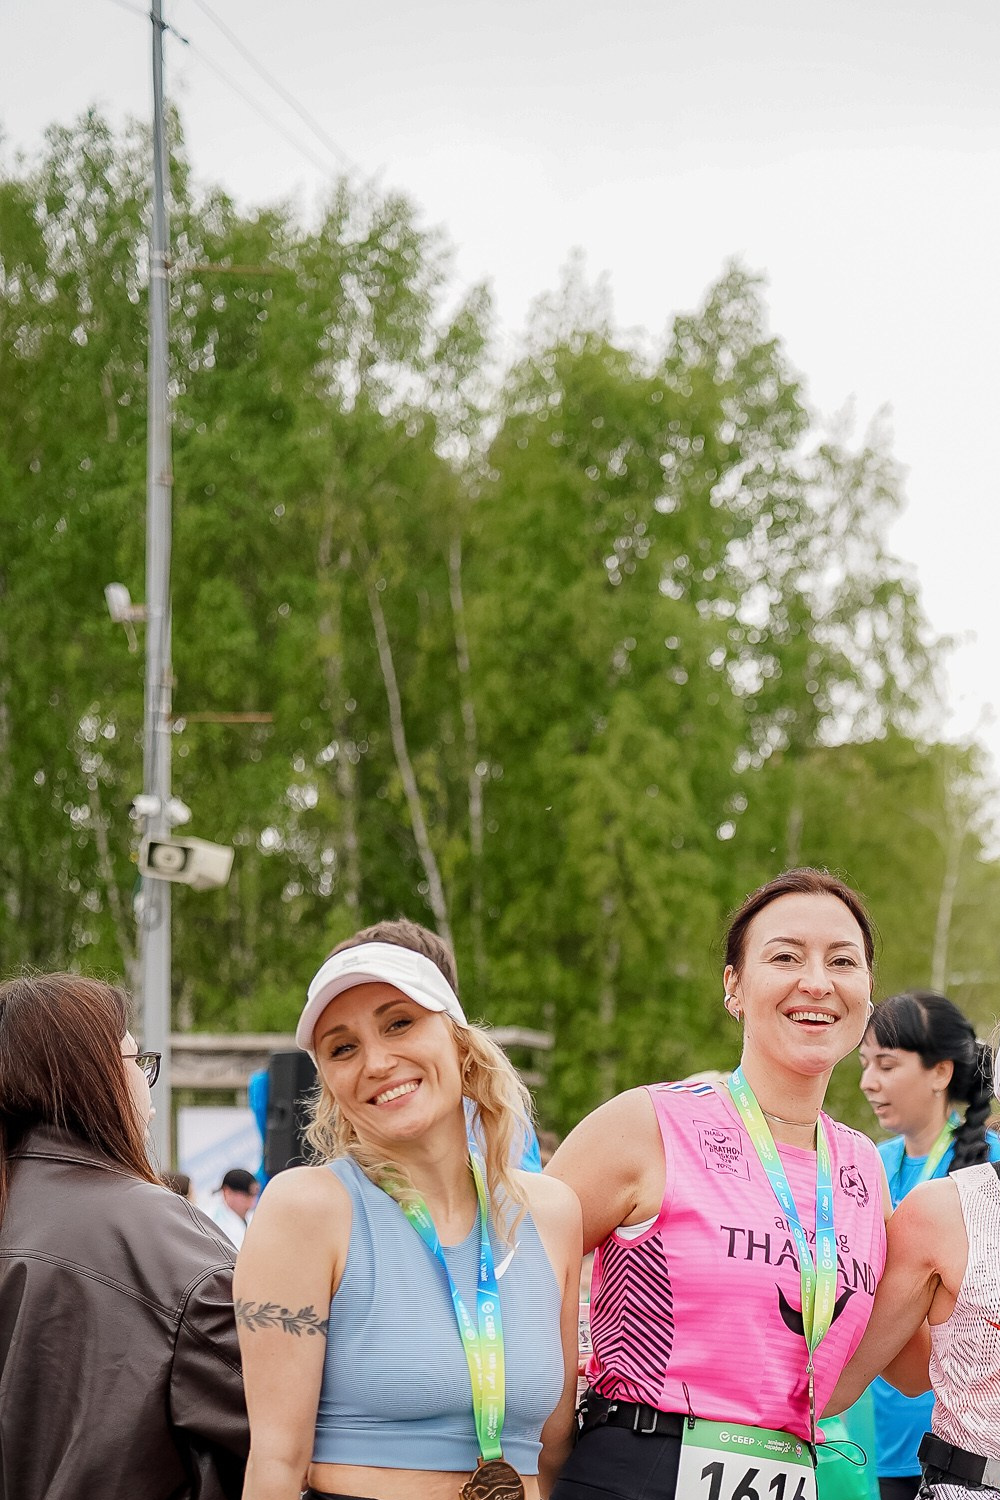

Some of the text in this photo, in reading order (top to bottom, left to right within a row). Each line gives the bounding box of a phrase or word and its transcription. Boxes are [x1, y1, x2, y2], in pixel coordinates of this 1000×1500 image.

[822, 1236, 831, 1259] СБЕР
[720, 1225, 877, 1297] THAAND
[731, 1434, 755, 1445] СБЕР
